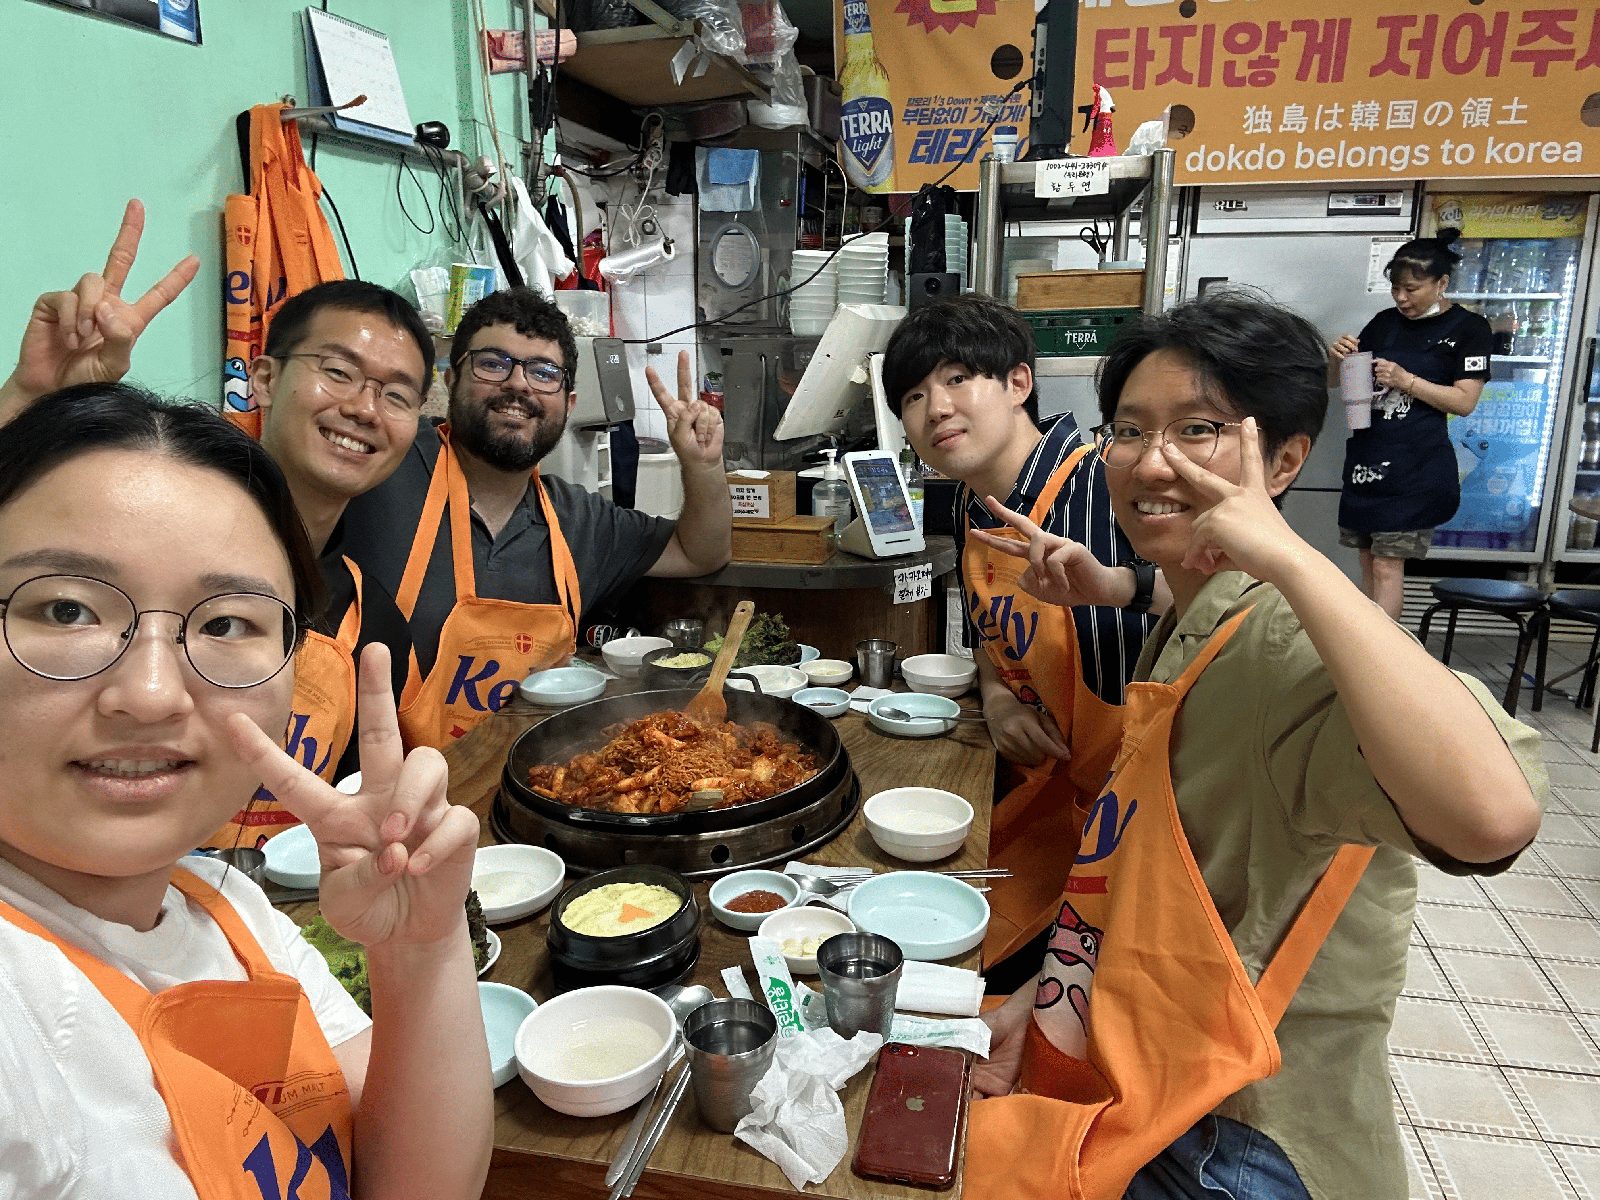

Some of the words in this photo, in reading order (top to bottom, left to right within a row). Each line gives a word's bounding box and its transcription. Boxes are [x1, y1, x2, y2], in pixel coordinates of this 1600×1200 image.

[1092, 17, 1352, 90] 타지않게
[947, 96, 972, 105] Down
[841, 110, 893, 139] TERRA
[902, 107, 966, 126] 부담없이
[1242, 97, 1529, 135] 独島は韓国の領土
[852, 136, 883, 157] Light
[908, 128, 986, 164] 테라
[1186, 143, 1291, 172] dokdo
[1295, 137, 1429, 176] belongs
[1440, 138, 1475, 166] to
[1485, 138, 1583, 165] korea
[1065, 330, 1098, 345] TERRA
[302, 1082, 326, 1095] MALT
